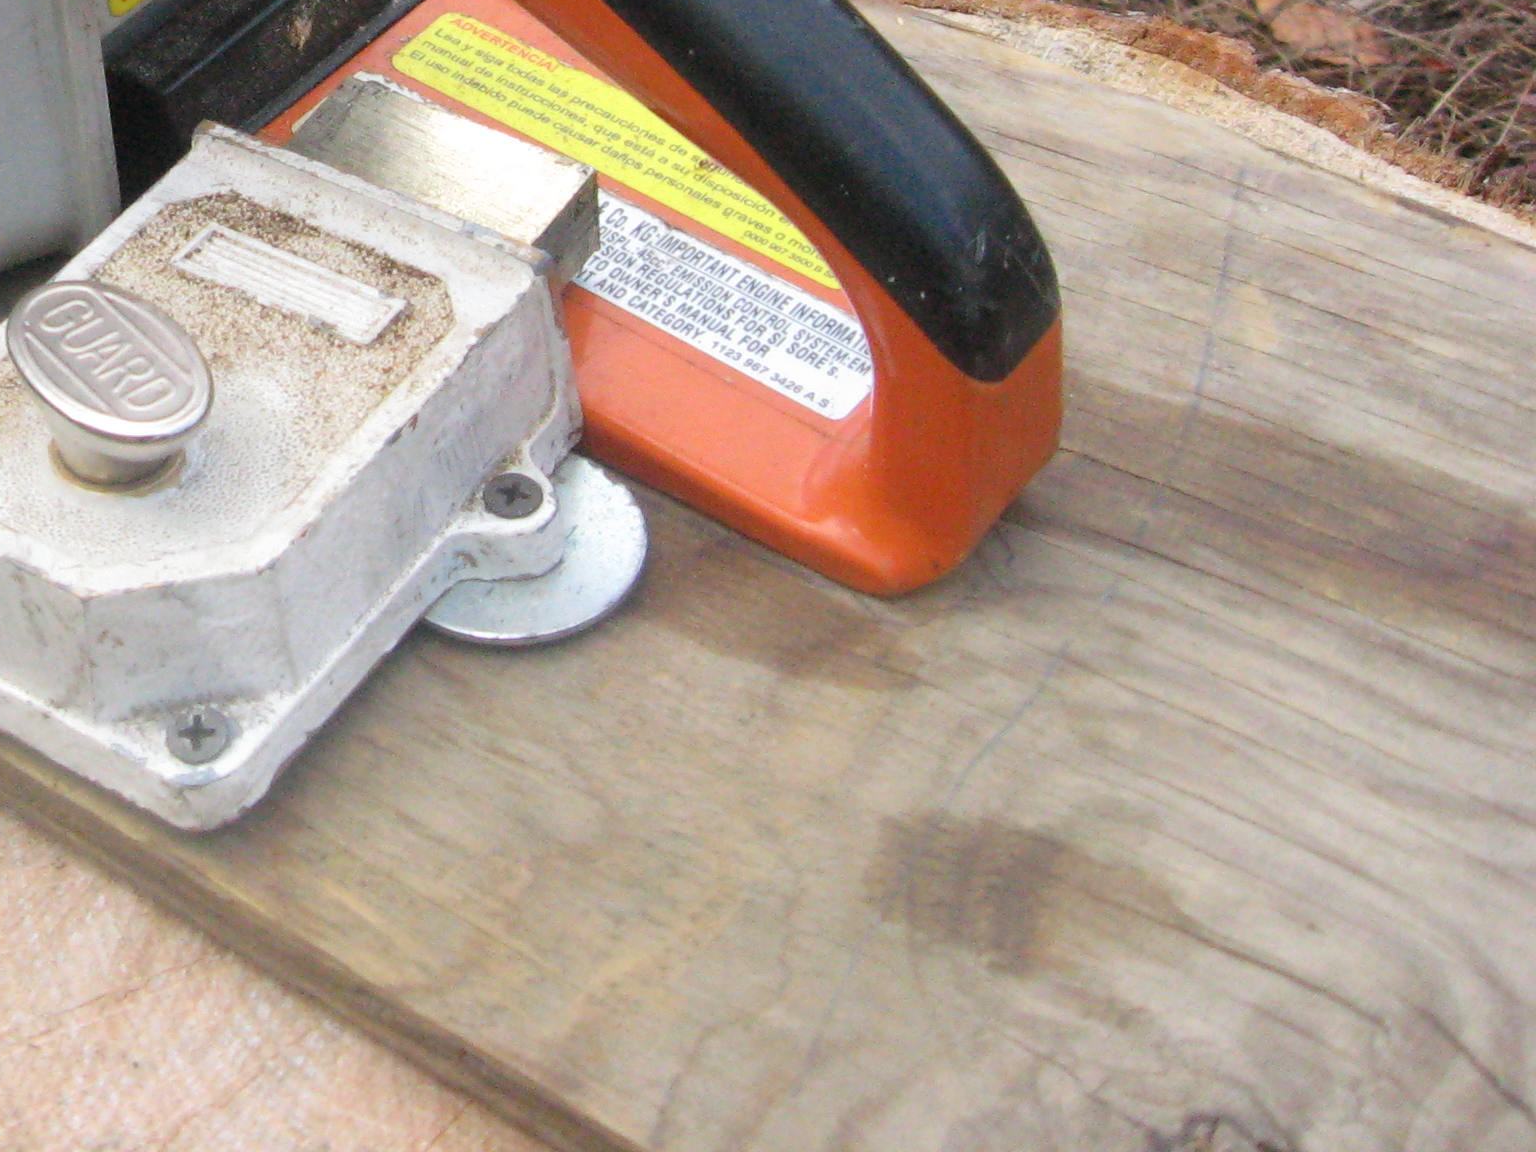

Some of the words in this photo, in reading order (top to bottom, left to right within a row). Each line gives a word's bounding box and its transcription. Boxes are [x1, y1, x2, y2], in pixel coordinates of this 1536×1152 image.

[434, 27, 462, 47] Lea
[460, 43, 474, 53] y
[475, 47, 504, 67] siga
[506, 60, 546, 87] todas
[548, 83, 569, 98] las
[569, 95, 667, 146] precauciones
[668, 141, 688, 157] de
[450, 17, 560, 73] ADVERTENCIA!
[408, 49, 424, 62] El
[426, 59, 450, 74] uso
[451, 71, 508, 103] indebido
[507, 99, 552, 125] puede
[552, 118, 602, 148] causar
[600, 145, 644, 170] daños
[643, 166, 723, 210] personales
[722, 206, 773, 235] graves
[774, 232, 787, 241] o
[422, 39, 474, 68] manual
[475, 65, 494, 79] de
[495, 75, 589, 127] instrucciones,
[592, 123, 622, 144] que
[623, 138, 656, 158] está
[657, 155, 669, 165] a
[671, 162, 691, 176] su
[693, 172, 777, 219] disposición
[588, 255, 609, 272] TO
[608, 267, 676, 308] OWNER'S
[675, 302, 736, 342] MANUAL
[737, 335, 771, 359] FOR
[605, 208, 629, 231] Co.
[656, 233, 741, 283] IMPORTANT
[735, 274, 794, 311] ENGINE
[635, 263, 735, 322] REGULATIONS
[734, 314, 768, 338] FOR
[767, 332, 786, 348] SI
[669, 264, 735, 302] EMISSION
[732, 297, 793, 335] CONTROL
[39, 299, 178, 412] GUARD
[593, 278, 628, 299] AND
[627, 295, 707, 345] CATEGORY.
[712, 340, 743, 361] 1123
[743, 358, 770, 375] 967
[769, 372, 804, 395] 3426
[803, 391, 817, 403] A
[817, 397, 830, 409] S
